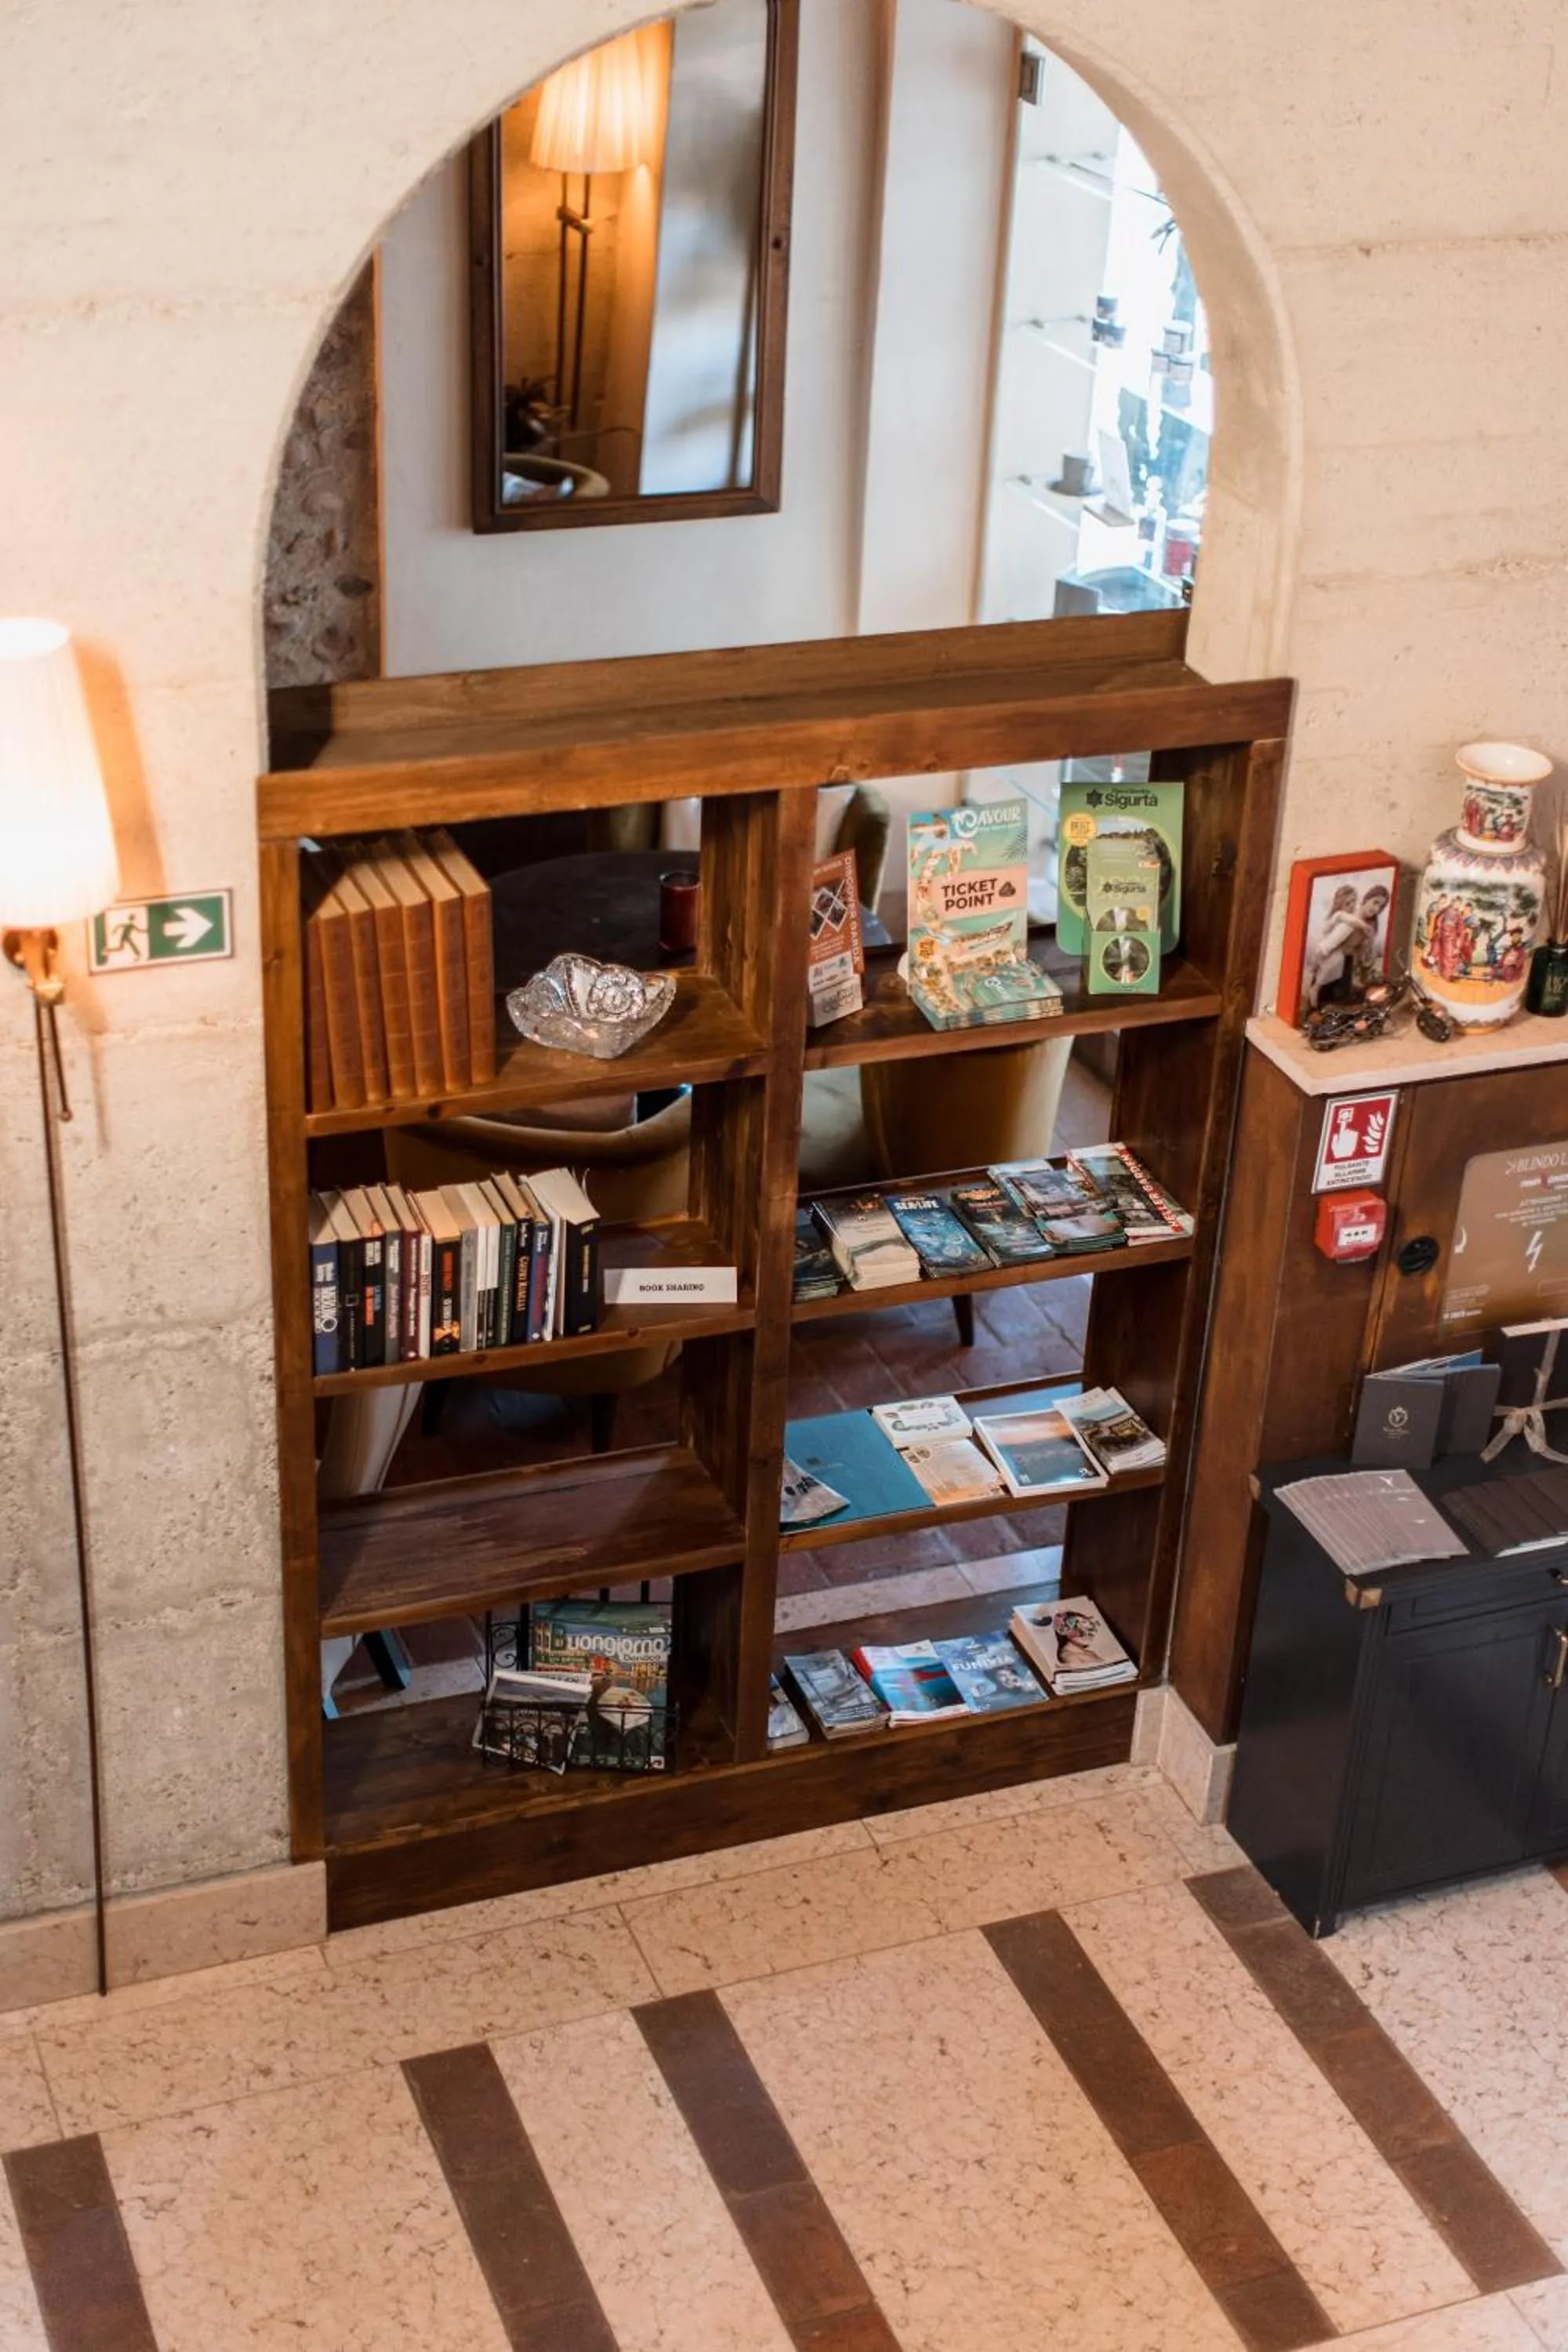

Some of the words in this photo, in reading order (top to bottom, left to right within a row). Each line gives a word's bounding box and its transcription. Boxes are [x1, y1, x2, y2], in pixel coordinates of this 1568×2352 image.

[941, 878, 997, 898] TICKET
[944, 893, 994, 912] POINT
[666, 1283, 705, 1291] SHARING
